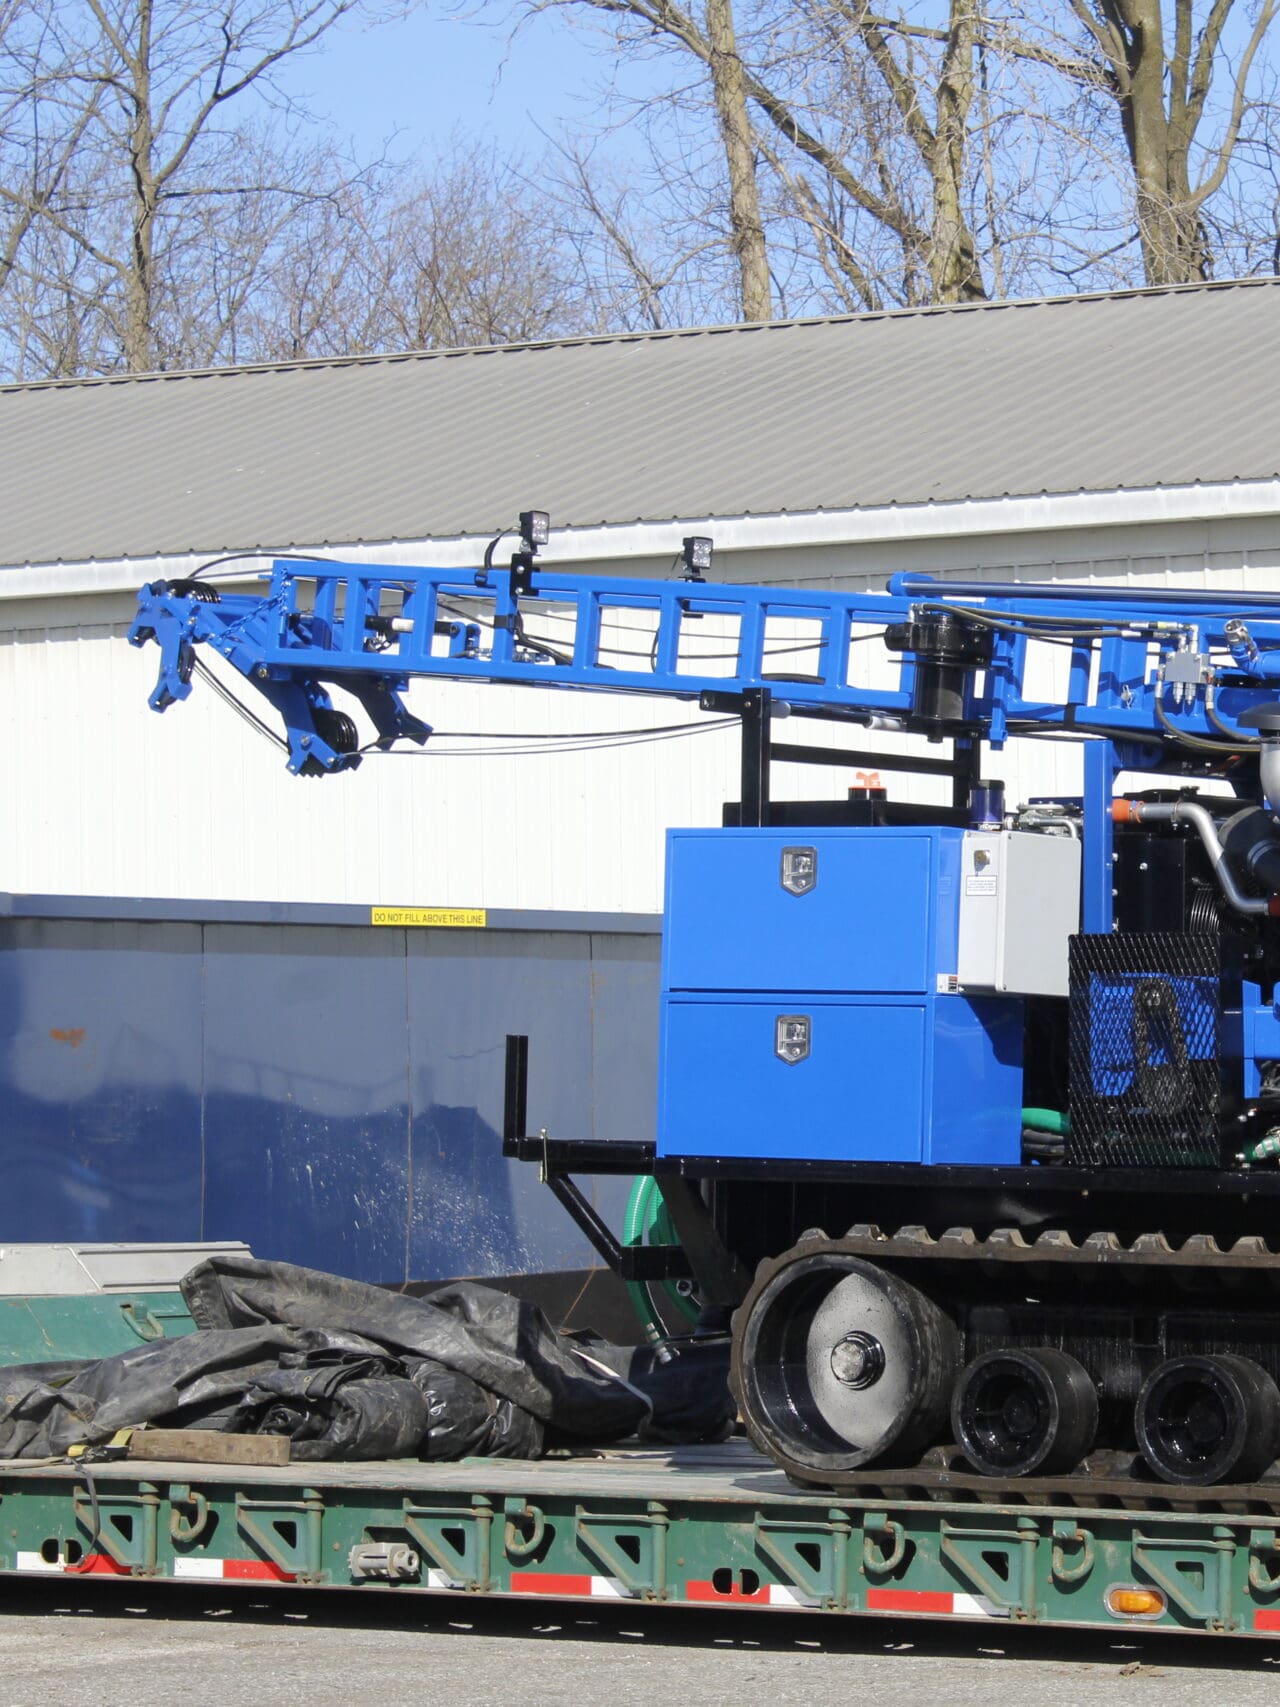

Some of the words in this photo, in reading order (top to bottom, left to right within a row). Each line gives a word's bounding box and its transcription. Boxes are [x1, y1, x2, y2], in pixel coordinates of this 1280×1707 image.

[374, 913, 386, 922] DO
[387, 913, 402, 922] NOT
[405, 914, 420, 923] FILL
[422, 914, 448, 923] ABOVE
[449, 915, 465, 924] THIS
[466, 915, 483, 924] LINE
